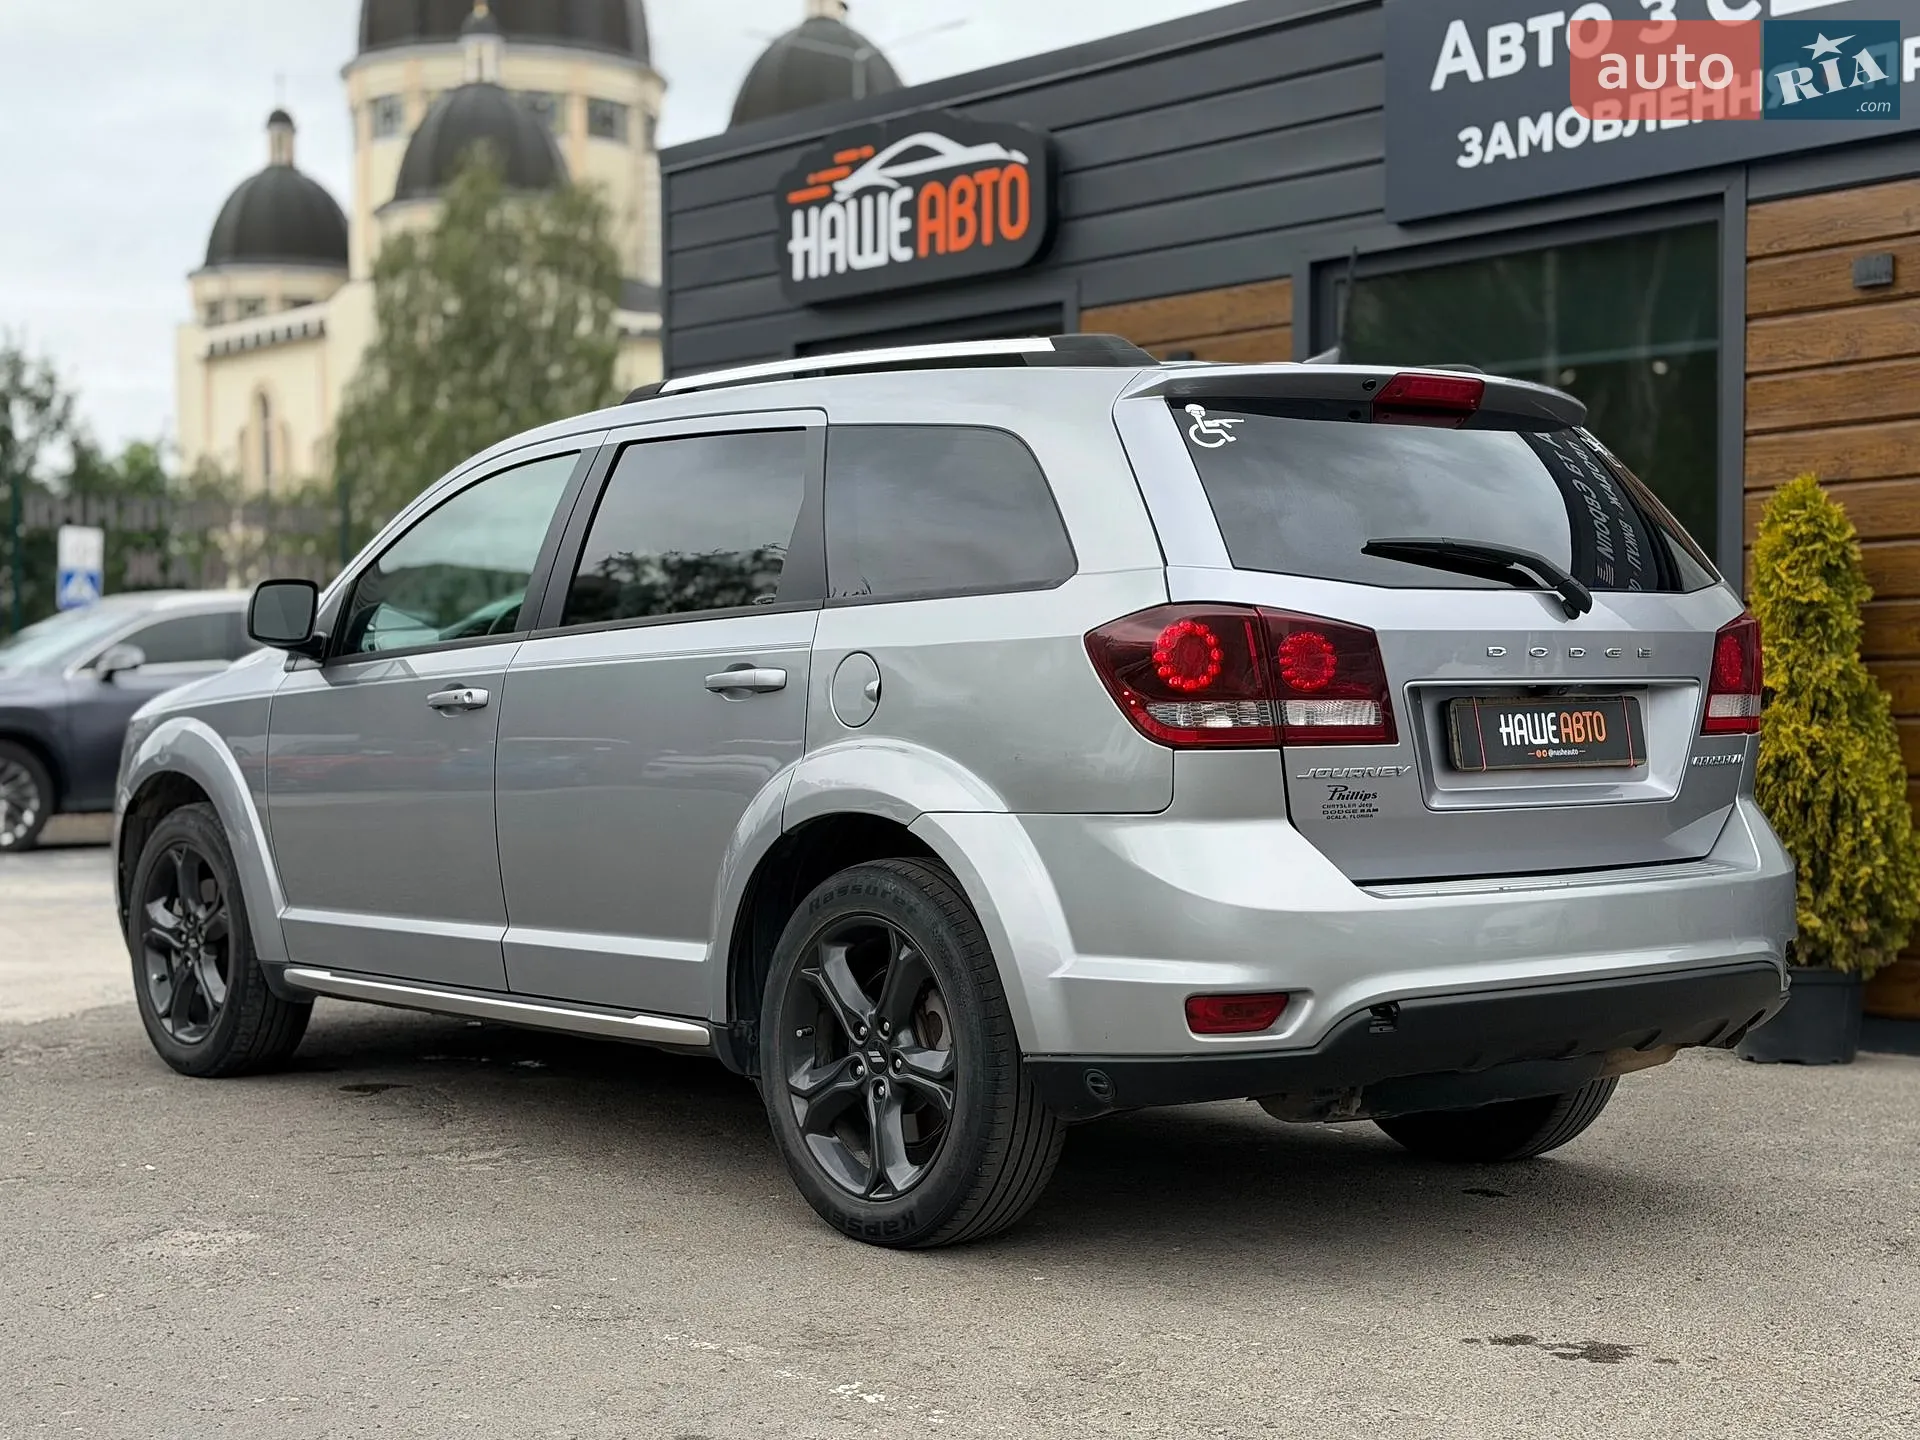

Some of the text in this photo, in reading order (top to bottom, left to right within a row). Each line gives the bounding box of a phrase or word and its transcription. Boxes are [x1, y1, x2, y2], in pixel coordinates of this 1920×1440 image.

[787, 163, 1030, 281] НАШЕ АВТО
[1487, 646, 1652, 658] DODGE
[1499, 711, 1607, 746] НАШЕ АВТО
[1296, 765, 1412, 779] JOURNEY
[1327, 785, 1378, 801] Phillips
